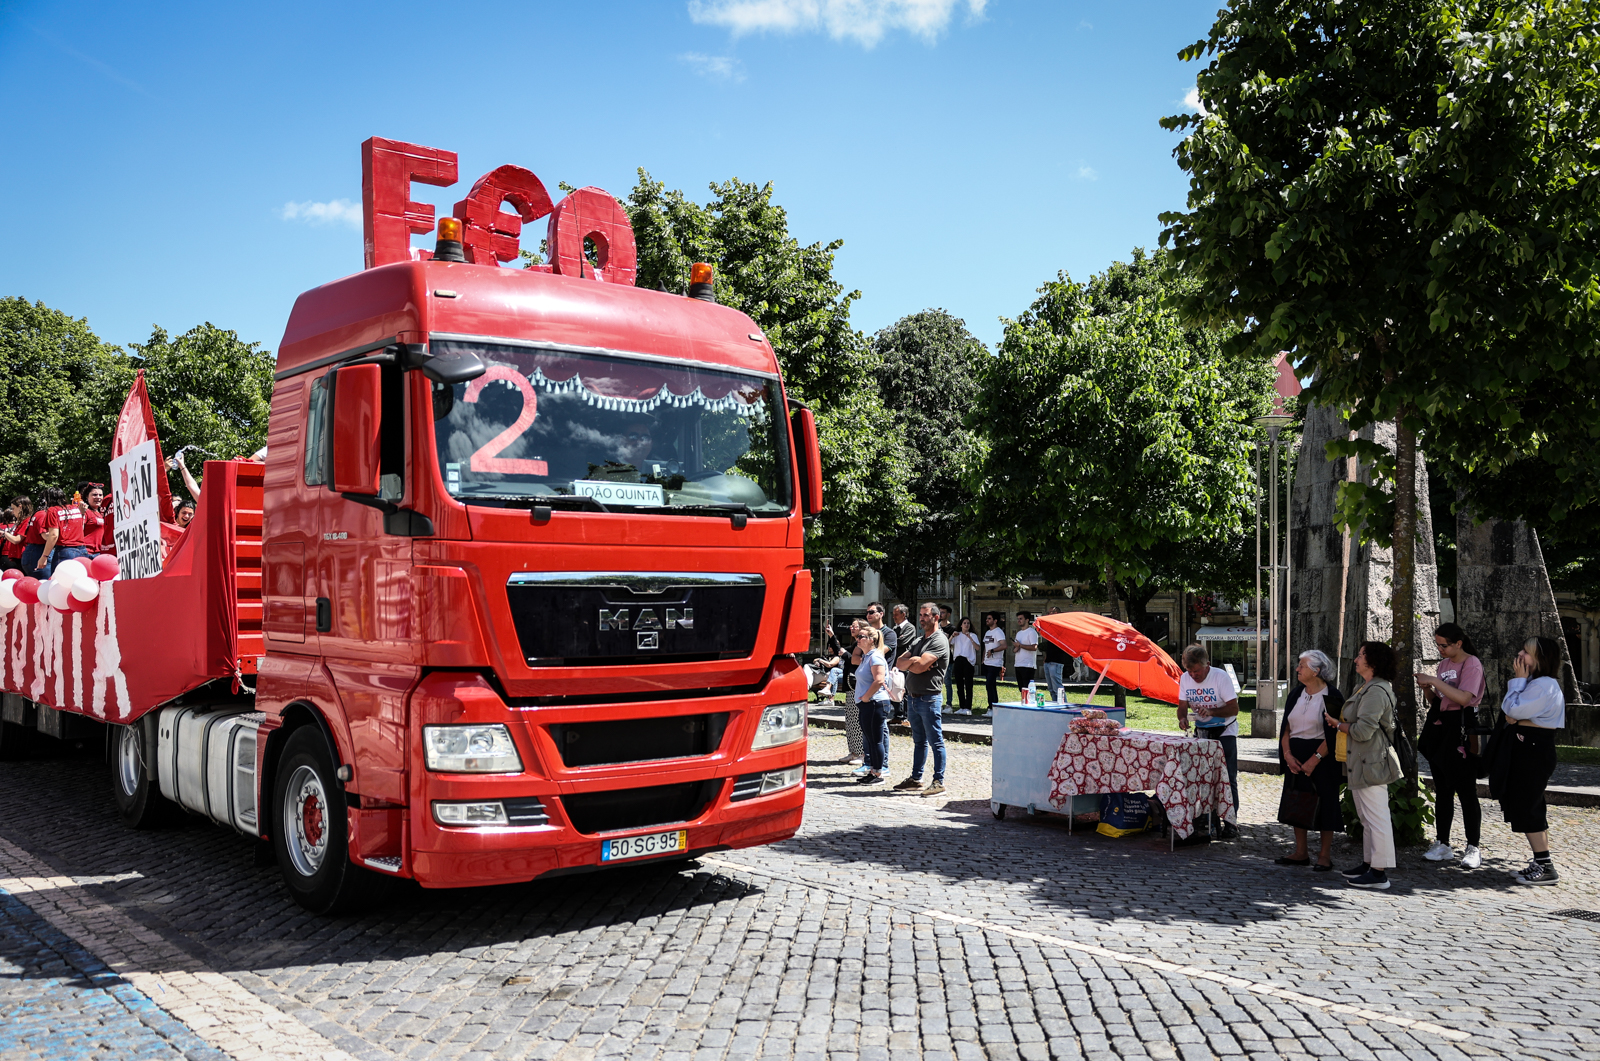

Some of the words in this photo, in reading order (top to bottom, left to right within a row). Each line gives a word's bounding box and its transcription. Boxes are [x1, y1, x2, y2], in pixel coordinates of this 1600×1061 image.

[463, 365, 549, 476] 2
[578, 486, 612, 499] JOÃO
[615, 488, 660, 501] QUINTA
[115, 528, 131, 553] TEM
[139, 519, 150, 545] DE
[599, 608, 694, 630] MAN
[1186, 688, 1215, 696] STRONG
[1187, 695, 1217, 703] CHARON
